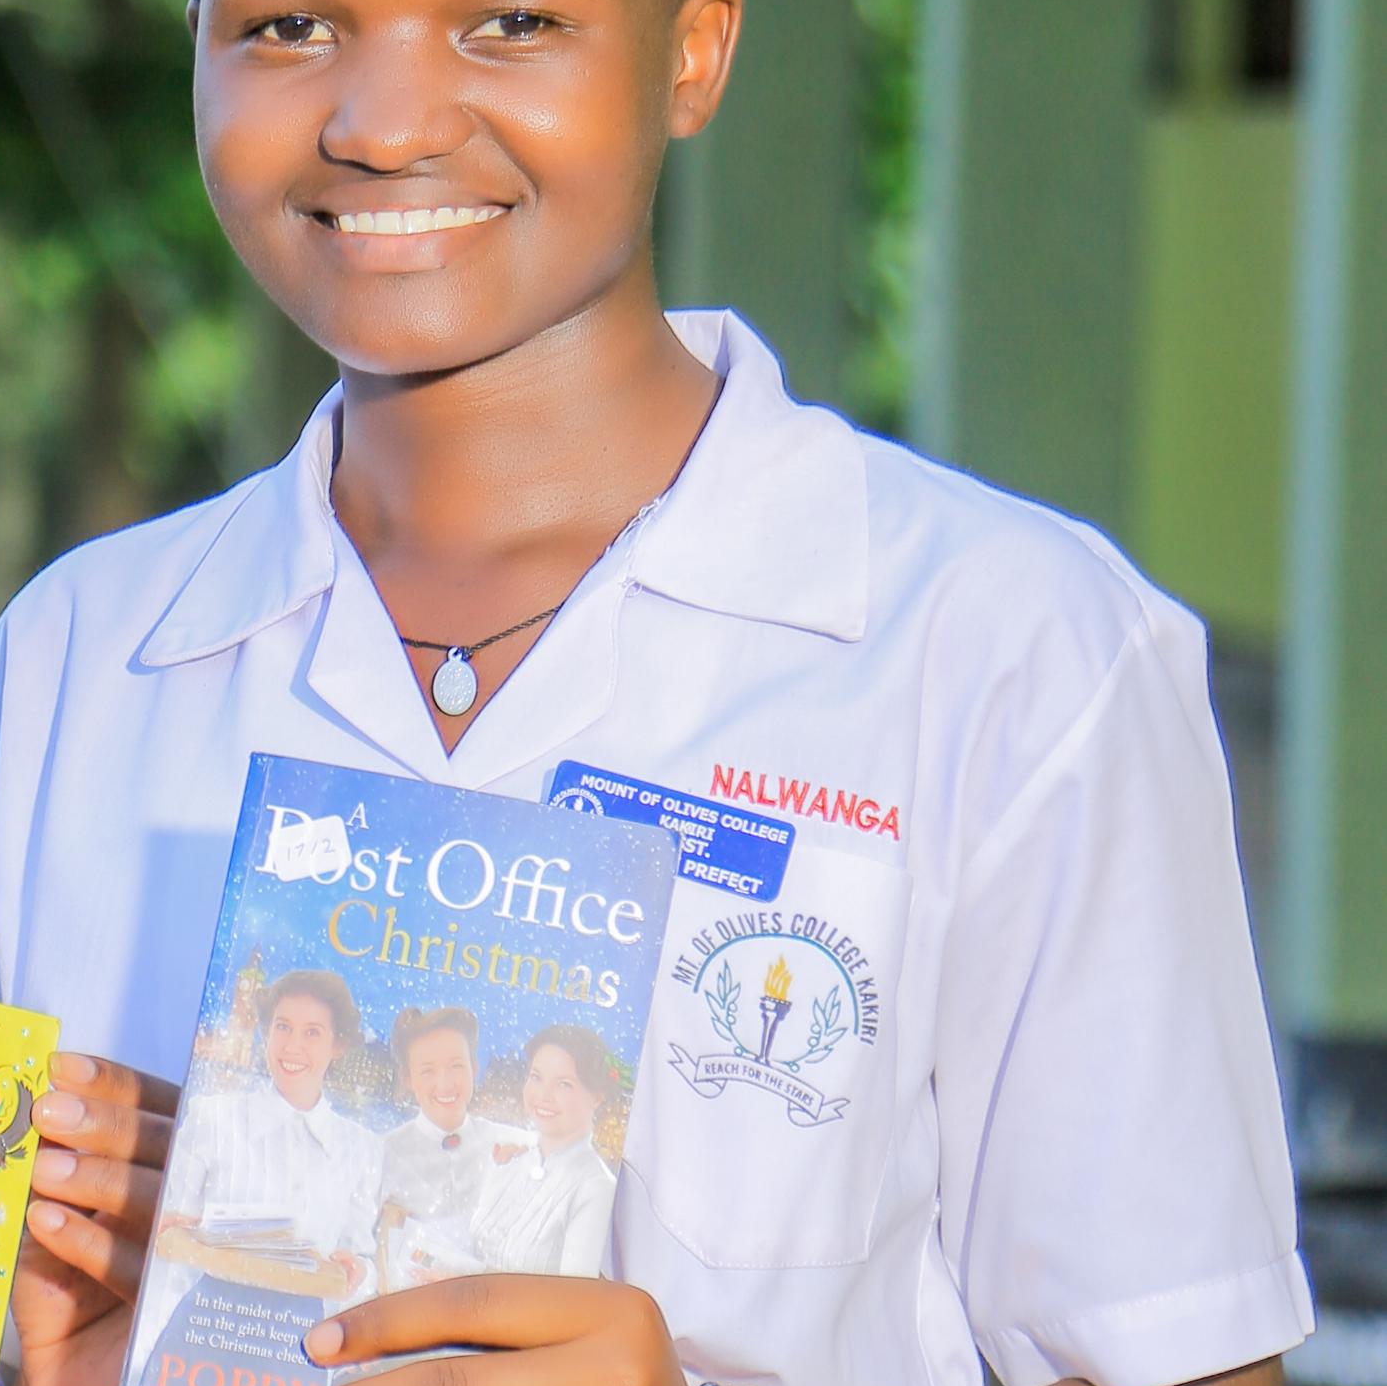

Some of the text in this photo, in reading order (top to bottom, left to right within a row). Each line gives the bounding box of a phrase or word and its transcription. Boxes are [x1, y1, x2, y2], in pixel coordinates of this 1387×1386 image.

[346, 802, 369, 829] A
[581, 774, 789, 844] MOUNT OF OLIVES COLLEGE
[710, 764, 900, 841] NALWANGA
[427, 839, 645, 945] Office
[683, 860, 763, 894] PREFECT
[327, 900, 621, 1008] Christmas
[671, 913, 879, 1045] MT. OF OLIVES COLLEGE KAKIRI
[704, 1062, 814, 1106] REACH FOR THE STARS
[189, 1314, 299, 1348] can the girls keep
[194, 1292, 315, 1328] In the midst of war
[185, 1330, 205, 1346] the
[208, 1333, 273, 1359] Christmas
